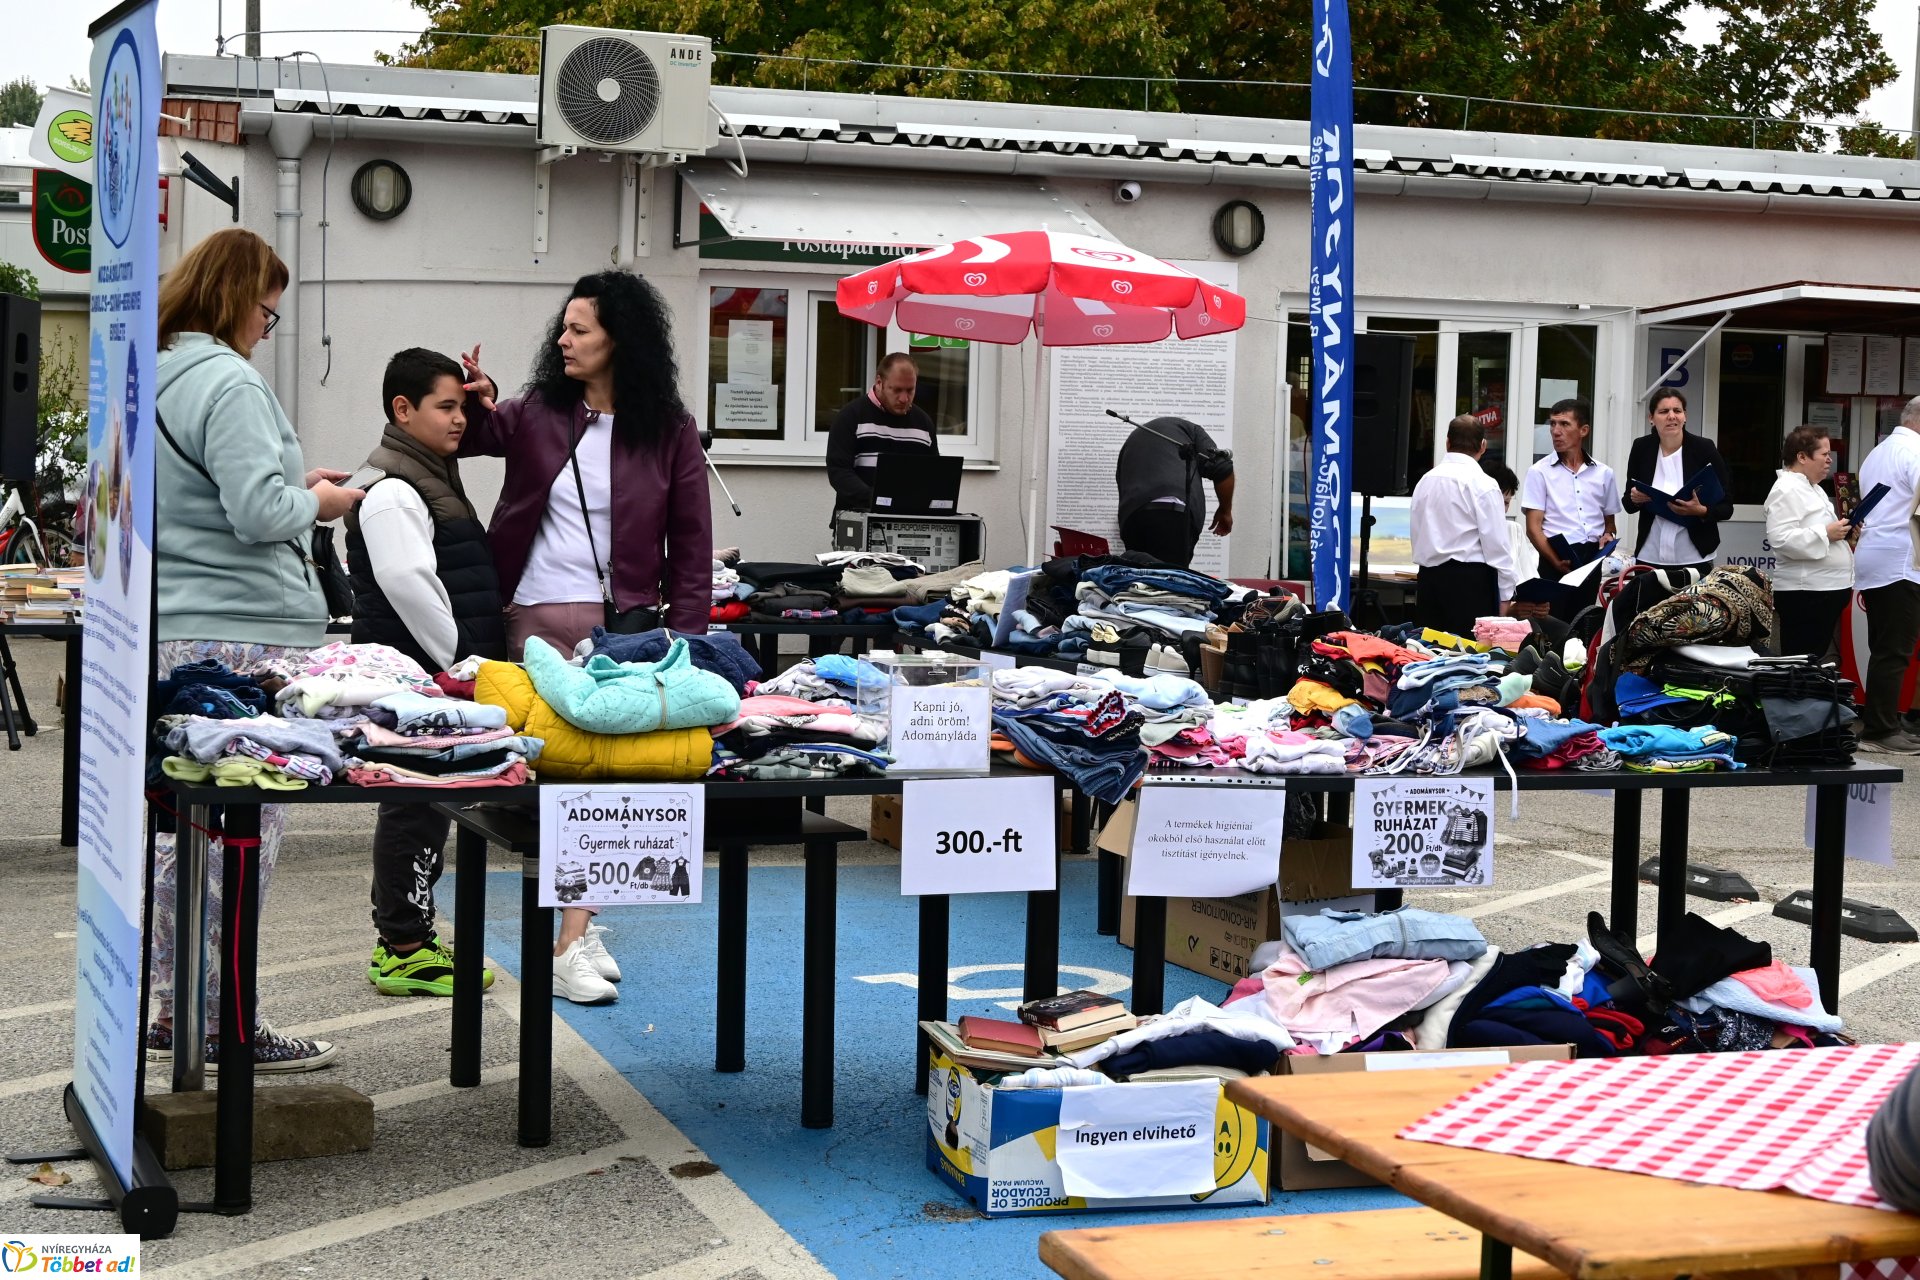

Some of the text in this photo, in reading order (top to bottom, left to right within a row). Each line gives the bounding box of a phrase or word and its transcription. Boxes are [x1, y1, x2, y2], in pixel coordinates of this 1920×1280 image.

[670, 48, 702, 61] ANDE
[1660, 347, 1689, 388] B
[893, 523, 930, 532] EUROPOWER
[913, 701, 963, 714] Kapni jó,
[910, 715, 969, 727] adni öröm!
[901, 729, 977, 742] Adományláda
[1409, 787, 1446, 795] ADOMÁNYSOR
[567, 805, 687, 822] ADOMÁNYSOR
[1373, 800, 1448, 817] GYERMEK
[1164, 819, 1253, 832] A termékek higiéniai
[1374, 816, 1438, 832] RUHÁZAT
[578, 834, 675, 854] Gyermek ruházat
[935, 827, 1023, 855] 300.-ft
[1147, 833, 1266, 847] okokból első használat előtt
[1383, 833, 1443, 855] 200 Ft/db
[1161, 848, 1249, 862] tisztítást igényelnek.
[587, 862, 649, 890] 500 Ft/db
[1191, 899, 1257, 931] AIR-CONDITIONER
[1075, 1124, 1197, 1146] Ingyen elvihető
[940, 1157, 965, 1187] BANANAS
[991, 1187, 1051, 1198] ECUADOR
[990, 1196, 1069, 1208] PRODUCE OF
